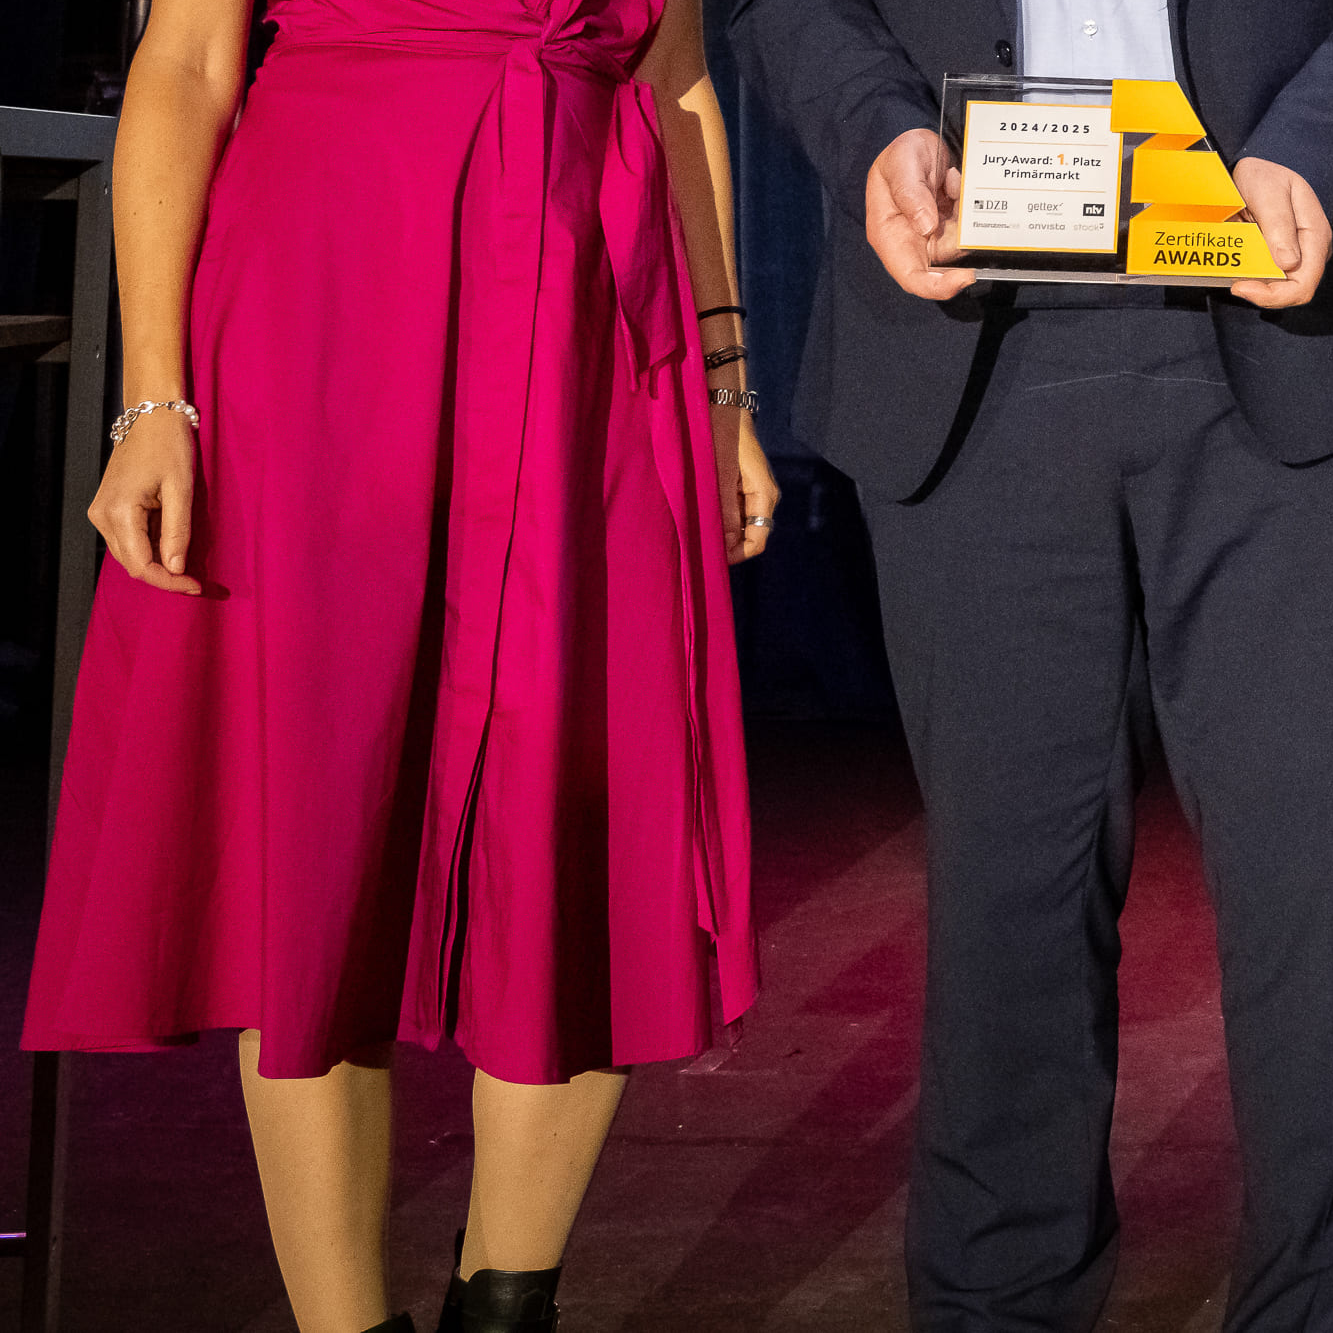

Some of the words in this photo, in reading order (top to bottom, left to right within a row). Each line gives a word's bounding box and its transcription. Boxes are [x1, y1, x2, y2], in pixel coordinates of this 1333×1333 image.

[1000, 122, 1090, 134] 2024/2025
[983, 153, 1053, 166] Jury-Award:
[1073, 156, 1101, 167] Platz
[1004, 168, 1080, 181] Primärmarkt
[986, 200, 1008, 211] DZB
[1085, 204, 1103, 215] ntv
[1154, 231, 1244, 248] Zertifikate
[1154, 250, 1242, 267] AWARDS
